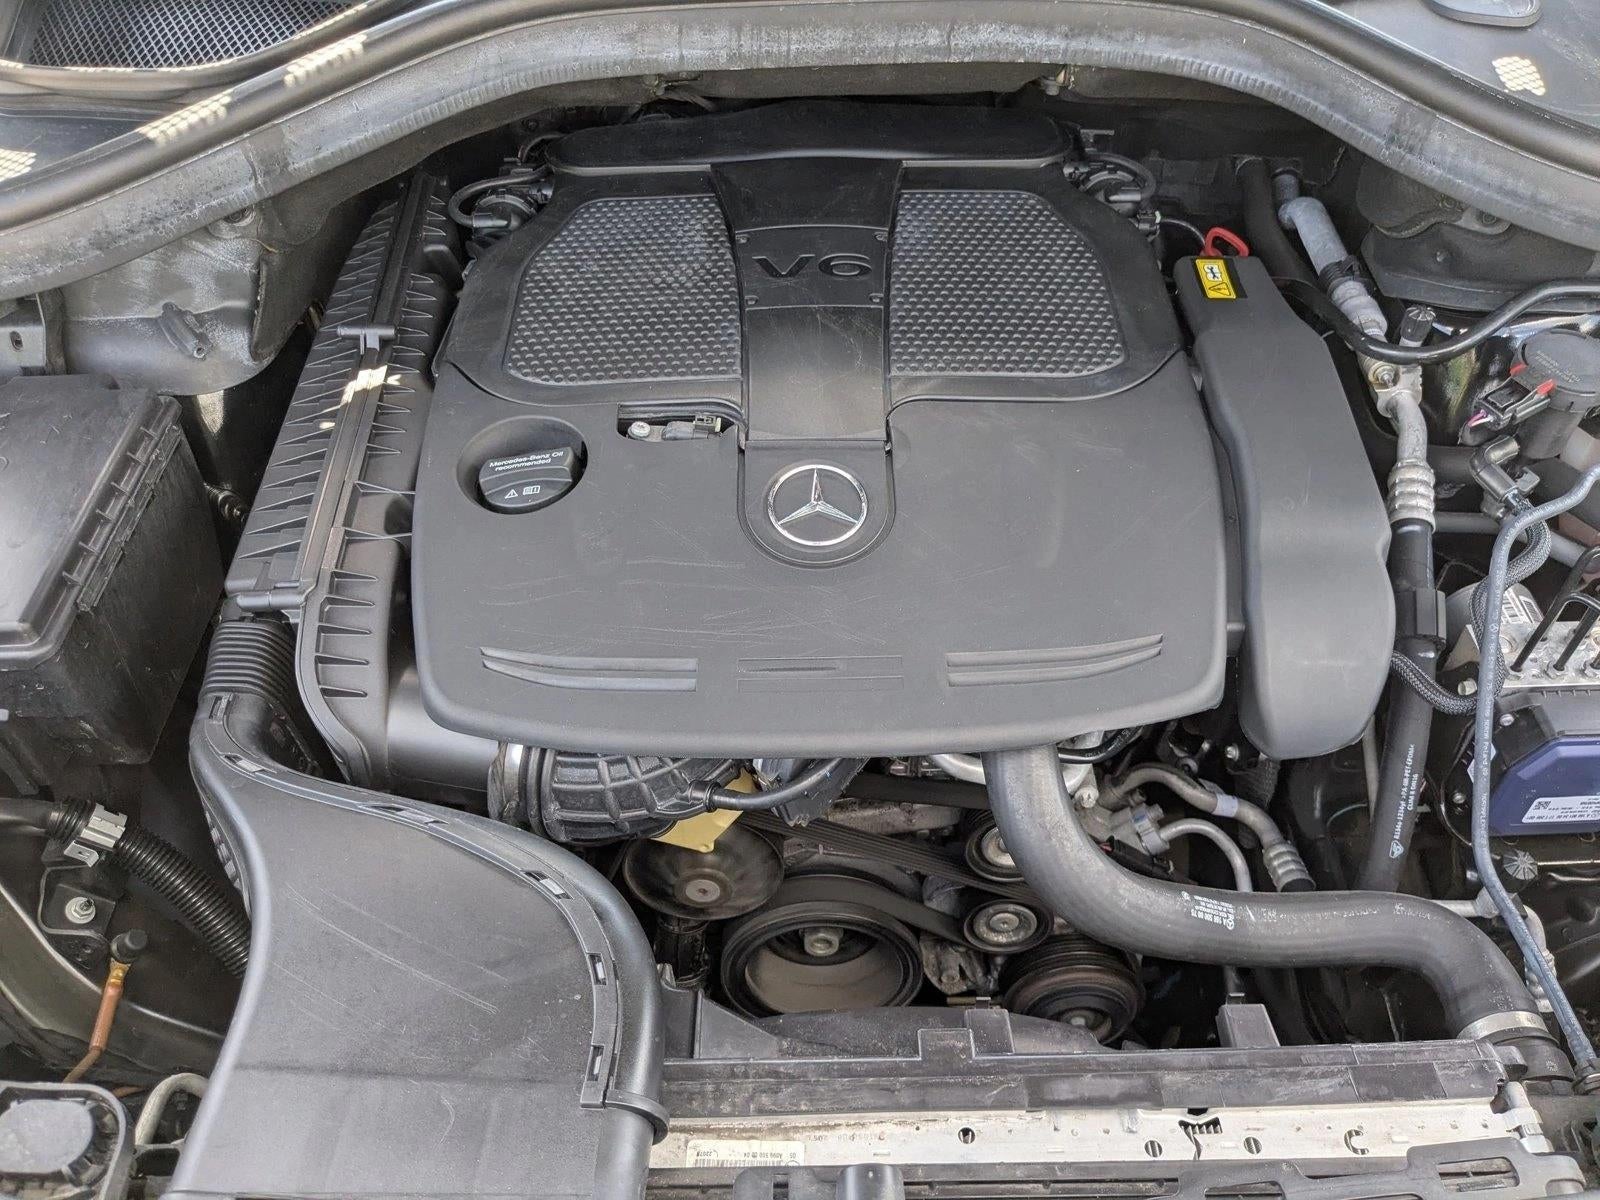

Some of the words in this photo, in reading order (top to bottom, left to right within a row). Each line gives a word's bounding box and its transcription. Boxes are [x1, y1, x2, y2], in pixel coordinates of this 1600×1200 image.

[752, 252, 872, 278] V6
[489, 454, 550, 467] Mercedes-Benz
[495, 458, 551, 471] recommended
